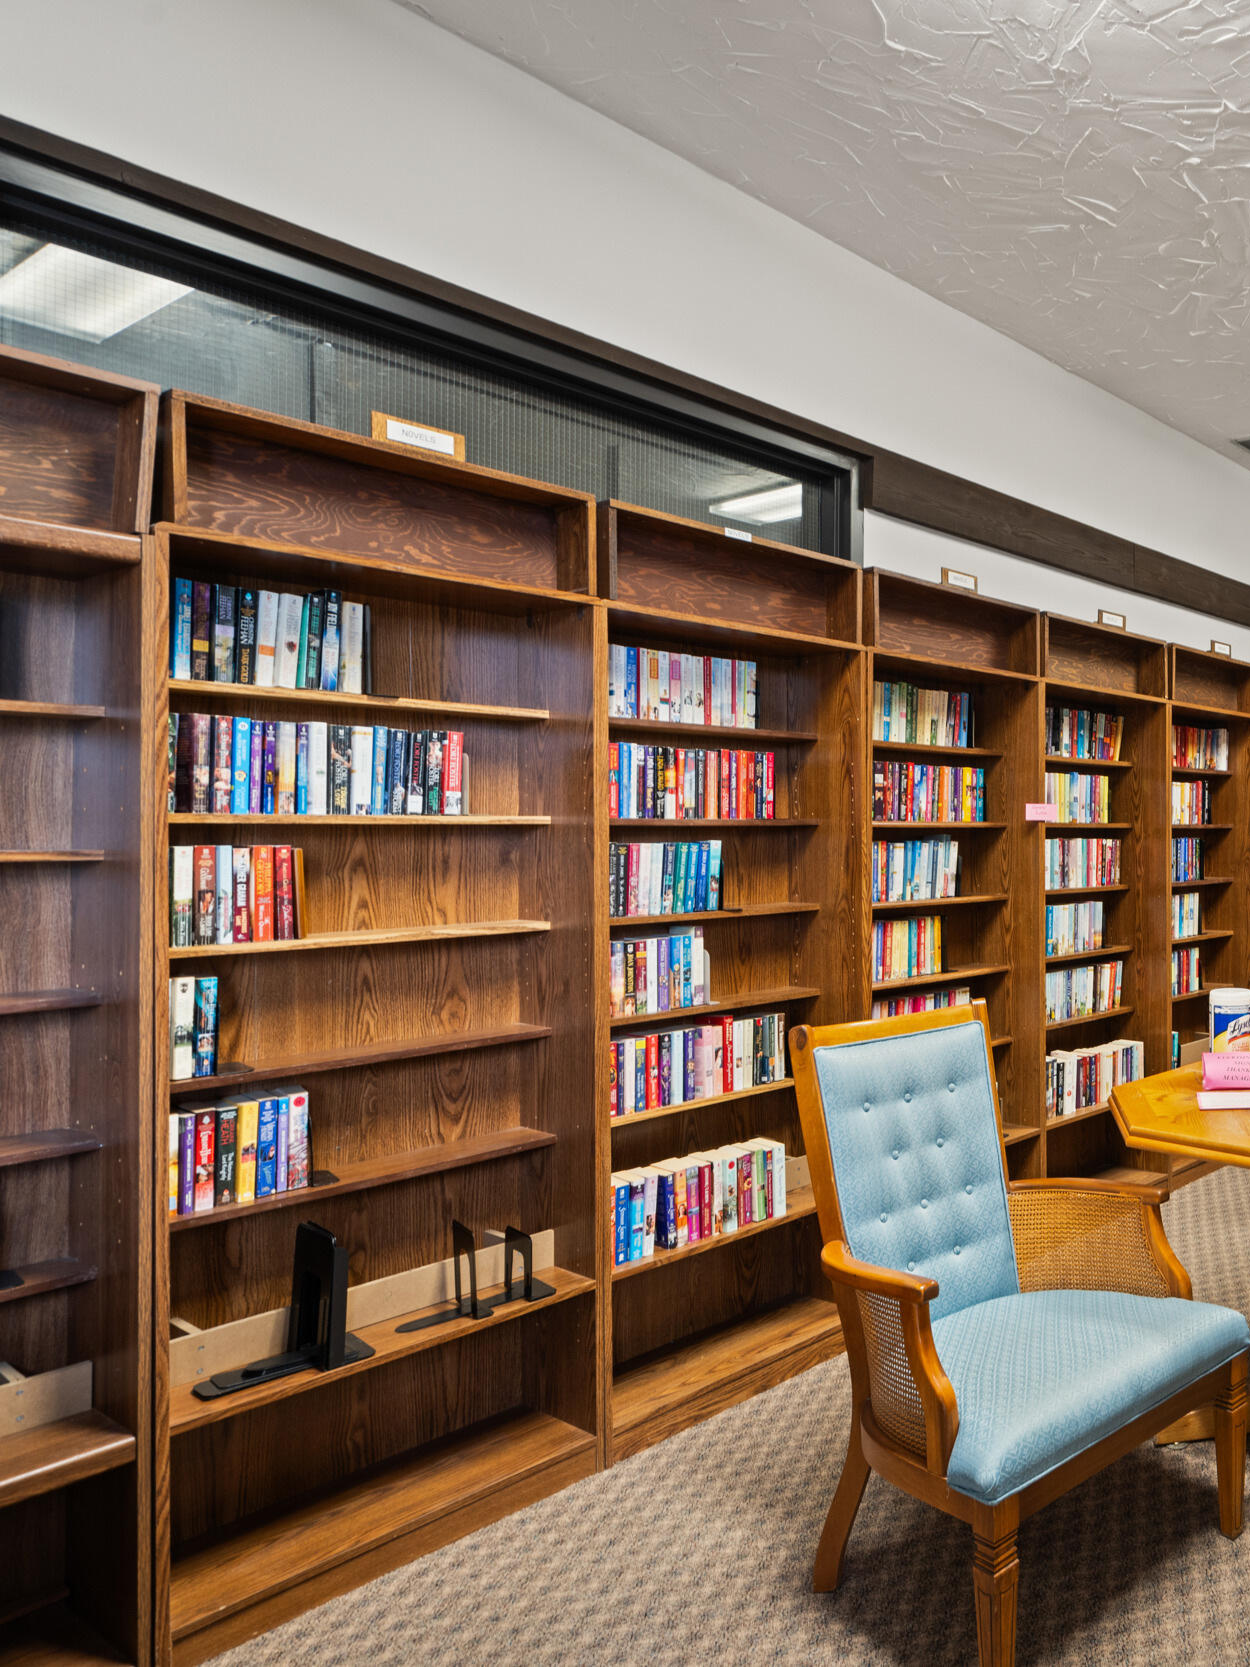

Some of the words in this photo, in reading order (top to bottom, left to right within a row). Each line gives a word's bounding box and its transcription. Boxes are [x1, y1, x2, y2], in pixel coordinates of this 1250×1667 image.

[401, 428, 436, 444] NOVELS
[240, 616, 249, 645] FEEHAN
[1230, 1017, 1250, 1034] Lysol
[220, 1119, 230, 1146] HEATH
